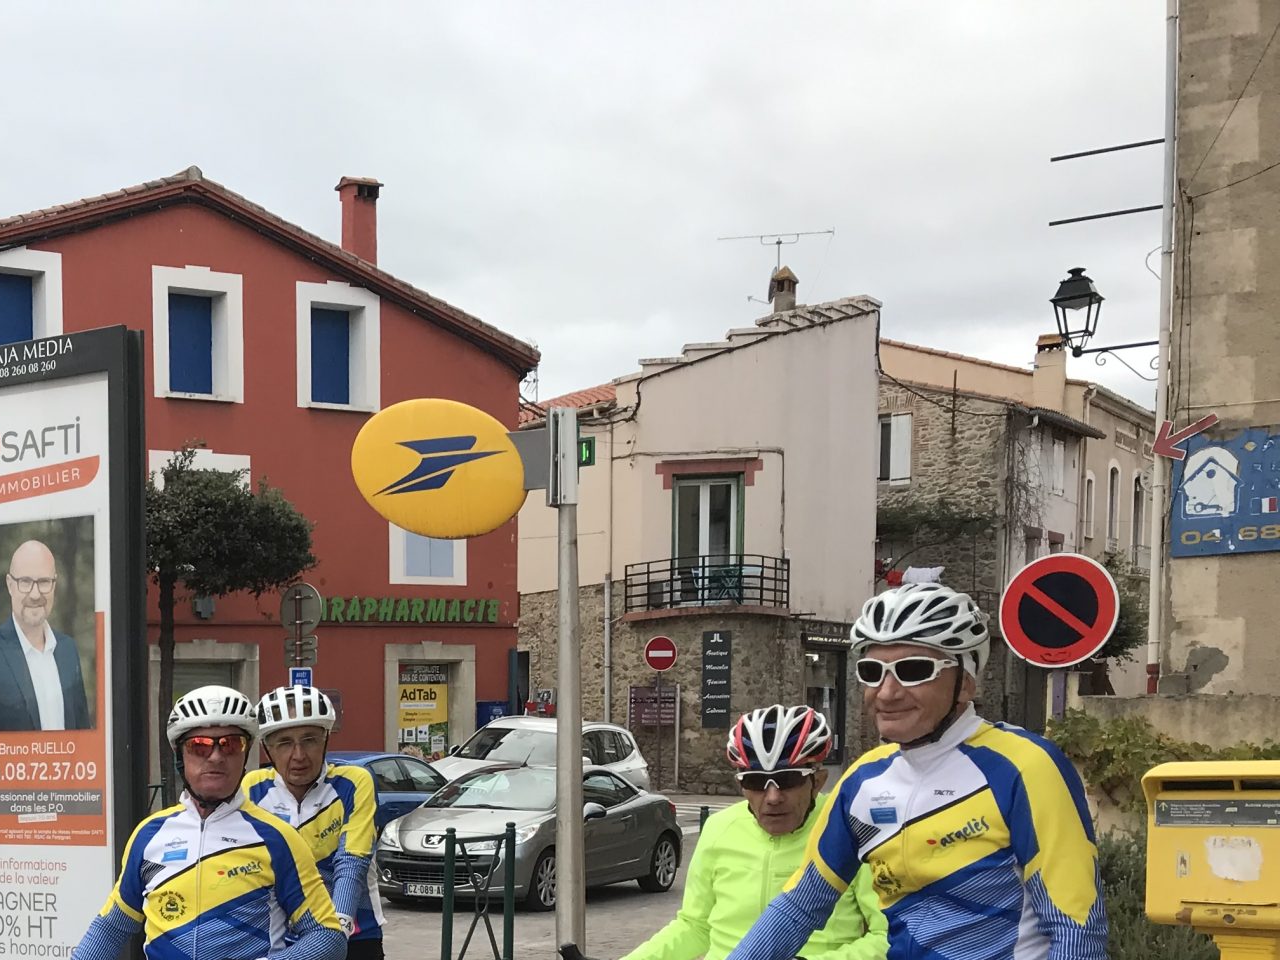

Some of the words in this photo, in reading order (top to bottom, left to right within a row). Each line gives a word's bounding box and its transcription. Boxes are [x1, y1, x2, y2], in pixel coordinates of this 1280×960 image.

[23, 338, 73, 359] MEDIA
[0, 368, 9, 378] 08
[11, 365, 27, 377] 260
[29, 363, 39, 373] 08
[41, 360, 56, 371] 260
[400, 688, 437, 701] AdTab
[31, 742, 75, 755] RUELLO
[37, 792, 49, 801] de
[50, 792, 101, 802] l'immobilier
[10, 803, 32, 813] dans
[33, 803, 46, 812] les
[0, 857, 67, 871] informations
[0, 871, 13, 884] de
[15, 872, 24, 884] la
[26, 872, 59, 885] valeur
[27, 916, 58, 939] HT
